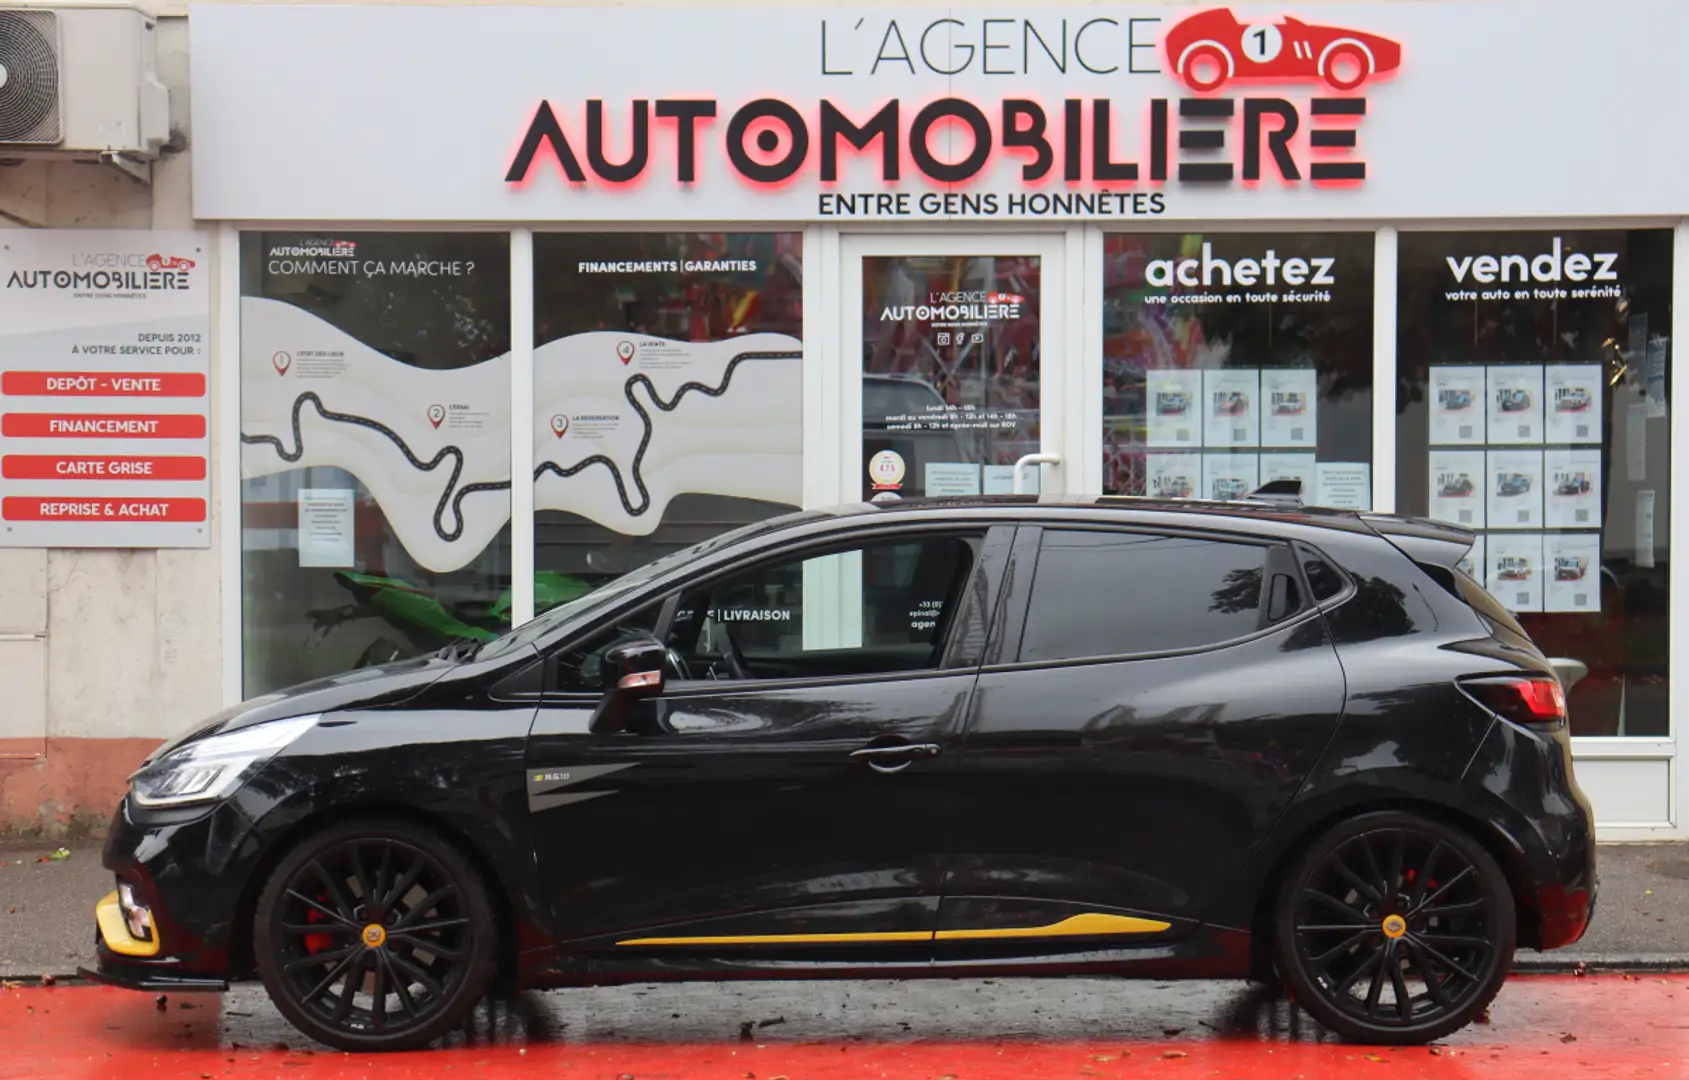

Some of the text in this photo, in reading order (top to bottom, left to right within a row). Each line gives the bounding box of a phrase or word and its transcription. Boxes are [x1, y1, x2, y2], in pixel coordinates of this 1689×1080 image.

[822, 17, 1161, 75] L'AGENCE
[1252, 29, 1266, 56] 1
[504, 98, 1367, 183] AUTOMOBILIERE
[818, 189, 1166, 215] ENTRE GENS HONNÊTES
[72, 253, 146, 268] L'AGENCE
[578, 260, 757, 273] FINANCEMENTS GARANTIES
[1145, 242, 1335, 287] achetez
[1446, 237, 1619, 283] vendez
[268, 260, 475, 279] COMMENT ÇA MARCHE ?
[6, 270, 190, 290] AUTOMOBILIERE
[930, 291, 986, 304] L'AGENCE
[1145, 290, 1332, 304] une occasion en toute sécurité
[1445, 290, 1478, 300] votre
[1481, 290, 1510, 300] auto
[1514, 290, 1530, 299] en
[1533, 288, 1567, 299] toute
[880, 304, 1021, 321] AUTOMOBILIERE
[137, 333, 202, 342] DEPUIS 2012
[82, 344, 117, 354] VOTRE
[119, 345, 163, 354] SERVICE
[164, 346, 195, 355] POUR
[46, 375, 98, 392] DEPÔT
[111, 378, 162, 392] VENTE
[49, 420, 159, 434] FINANCEMENT
[56, 461, 153, 475] CARTE GRISE
[40, 502, 169, 517] REPRISE & ACHAT
[723, 609, 791, 621] LIVRAISON
